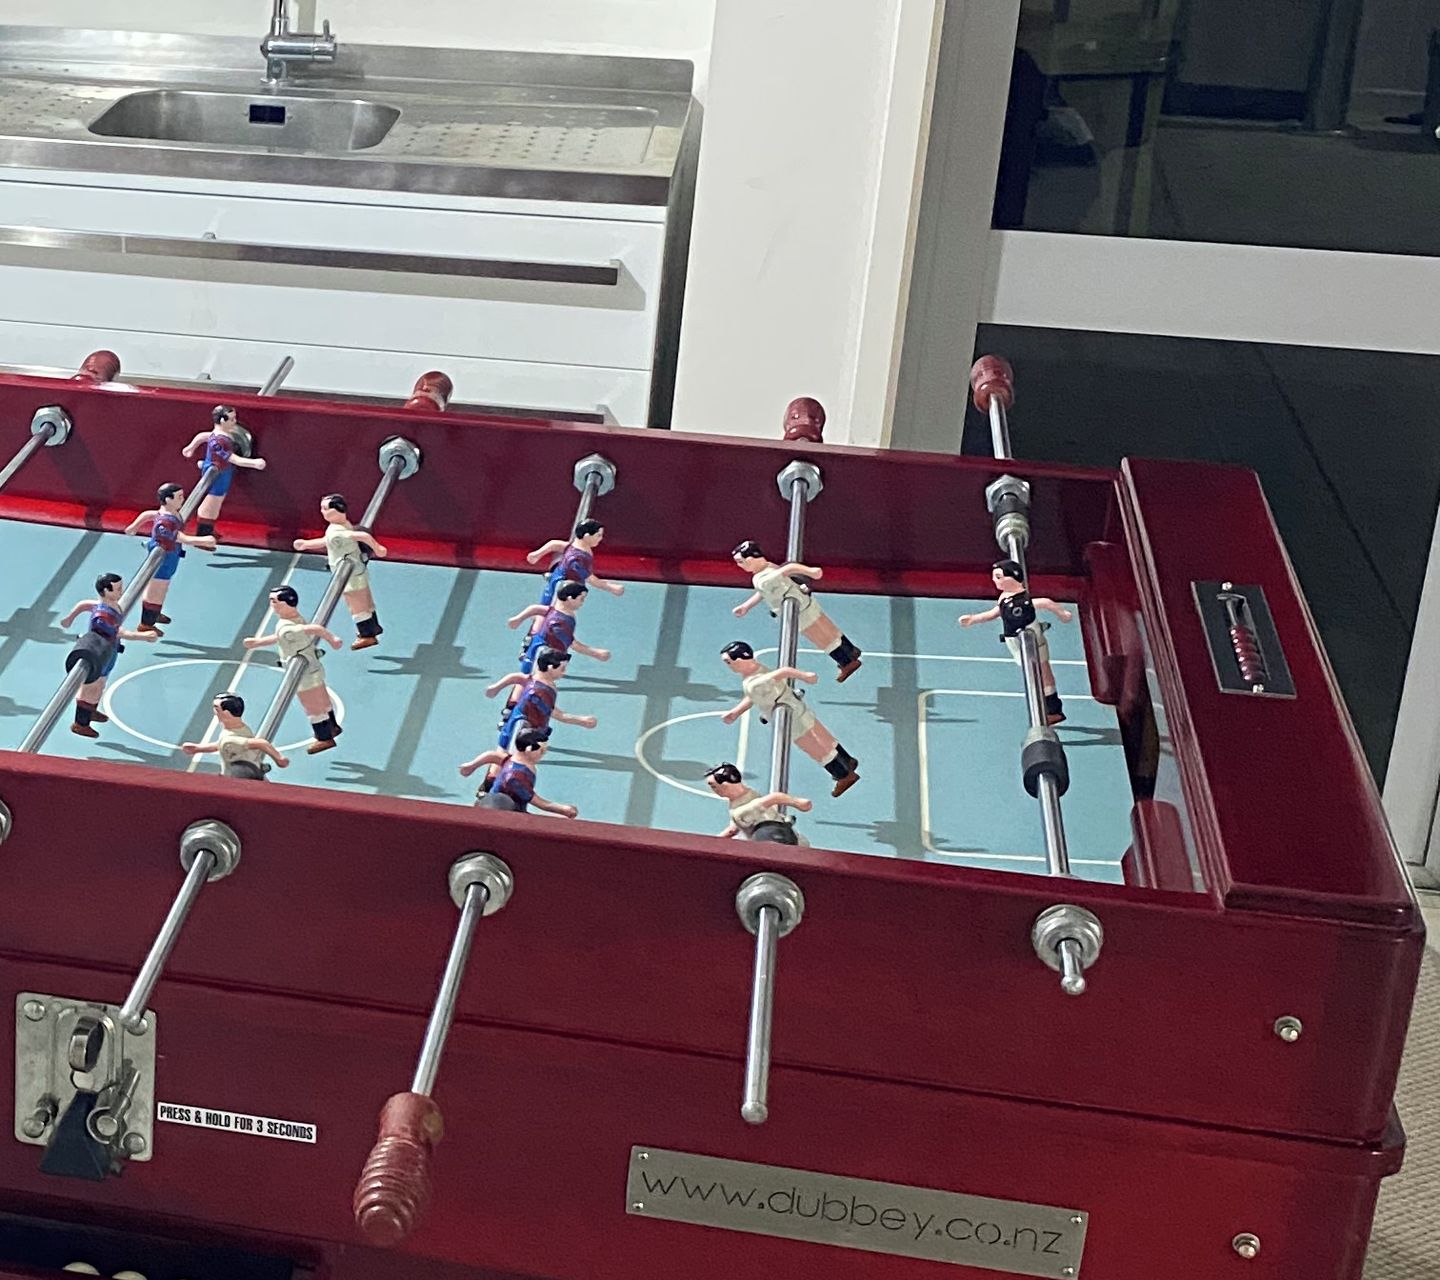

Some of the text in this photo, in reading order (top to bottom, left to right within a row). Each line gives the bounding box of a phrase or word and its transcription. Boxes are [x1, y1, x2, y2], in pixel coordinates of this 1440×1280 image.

[160, 1105, 313, 1140] PRESS & HOLD FOR 3 SECONDS
[641, 1170, 1064, 1255] www.dubbey.co.nz
